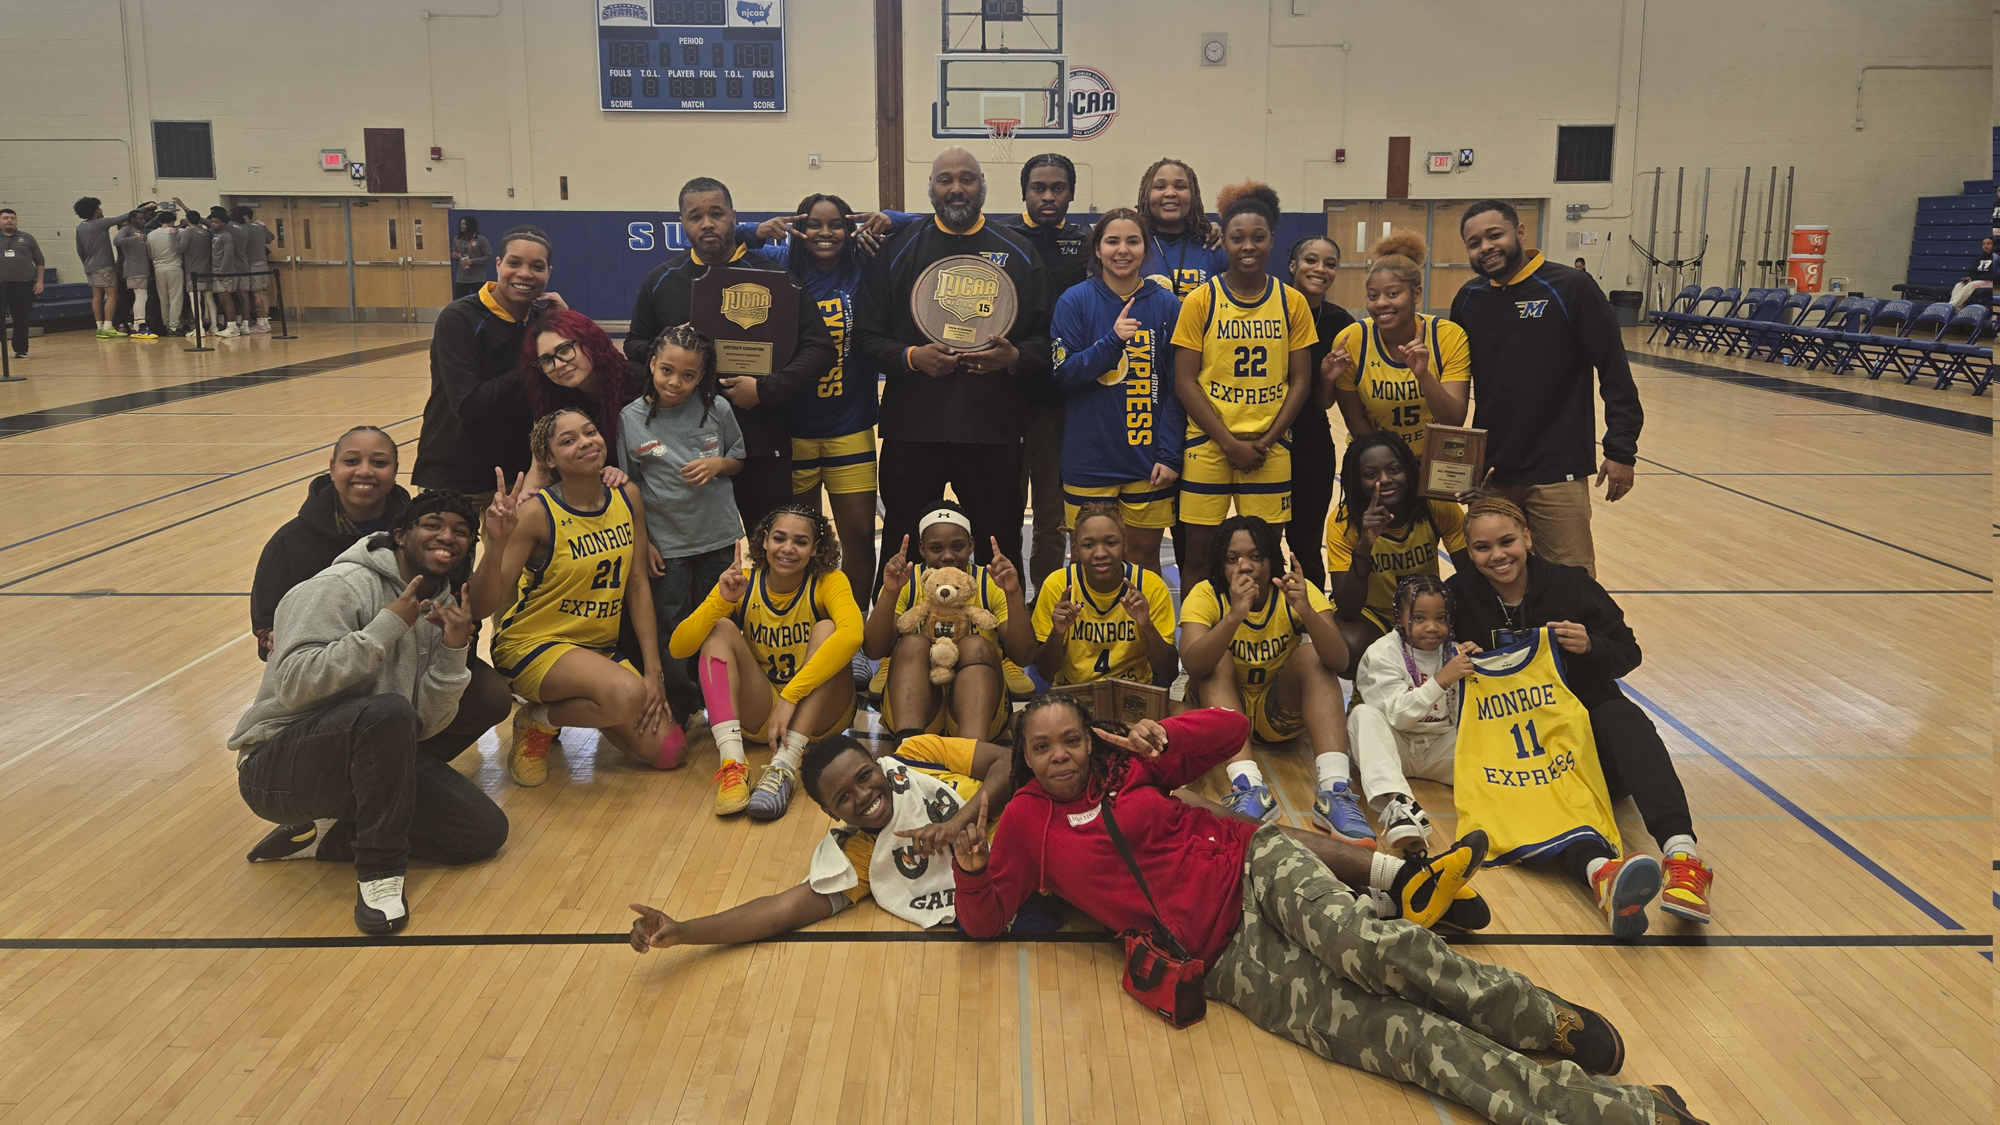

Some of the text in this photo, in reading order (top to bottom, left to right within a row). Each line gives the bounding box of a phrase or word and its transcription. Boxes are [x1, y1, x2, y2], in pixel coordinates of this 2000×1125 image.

[602, 8, 648, 21] SHARKS
[679, 37, 704, 45] PERIOD
[640, 70, 661, 78] T.O.L.
[668, 70, 695, 78] PLAYER
[699, 70, 717, 78] FOUL
[610, 100, 633, 108] SCORE
[753, 101, 775, 109] SCORE
[1434, 156, 1449, 167] EXIT
[1807, 265, 1818, 274] G
[938, 273, 997, 297] NJCAA
[724, 291, 770, 310] NJCAA
[947, 300, 991, 313] REGION 15
[1217, 319, 1282, 340] MONROE
[1234, 346, 1267, 377] 22
[1126, 329, 1153, 446] EXPRESS
[1210, 380, 1283, 405] EXPRESS
[1371, 379, 1426, 401] MONR
[1391, 404, 1421, 427] 15
[567, 522, 633, 560] MONROE
[1369, 543, 1434, 573] MONROE
[590, 555, 622, 590] 21
[558, 598, 623, 619] EXPRE
[750, 622, 811, 648] MONROE
[1071, 620, 1136, 644] MONROE
[1228, 634, 1289, 662] MONROE
[767, 653, 796, 680] 13
[1093, 649, 1110, 674] 4
[1247, 667, 1266, 685] 0
[1476, 684, 1557, 721] MONROE
[1510, 719, 1546, 760] 11
[1483, 750, 1576, 788] EXPRESS
